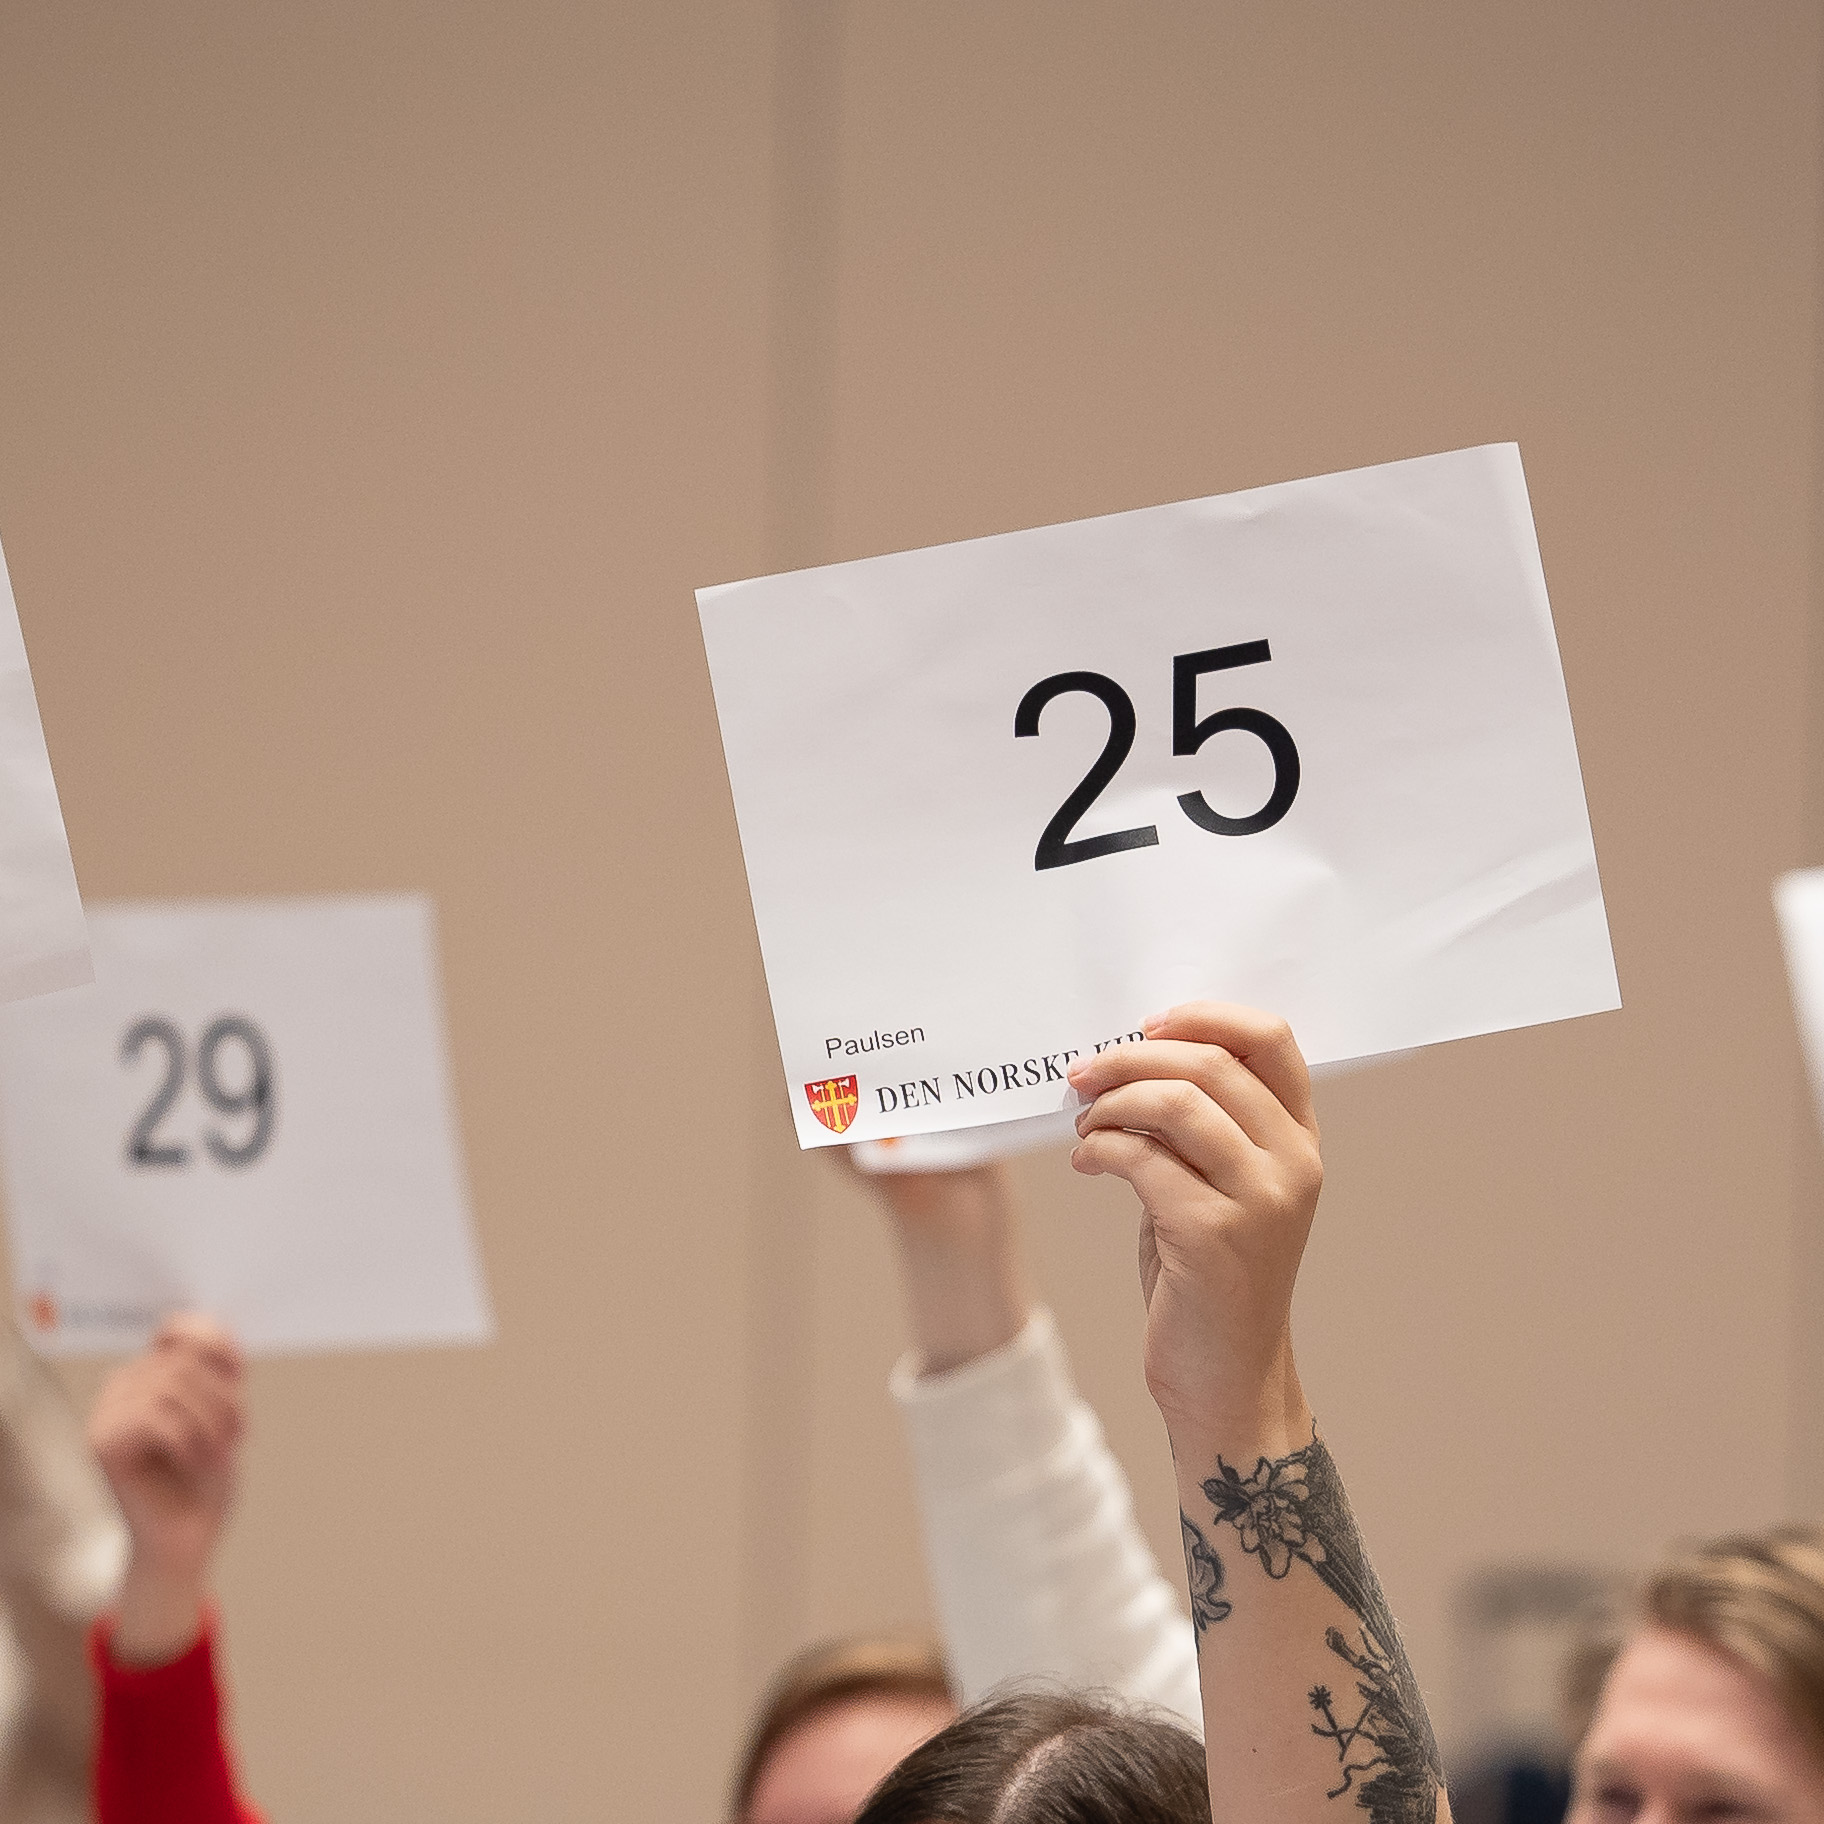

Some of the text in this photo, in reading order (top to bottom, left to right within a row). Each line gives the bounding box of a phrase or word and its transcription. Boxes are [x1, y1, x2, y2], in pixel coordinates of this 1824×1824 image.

[1014, 638, 1301, 872] 25
[824, 1026, 926, 1059] Paulsen
[119, 1014, 278, 1172] 29
[875, 1076, 943, 1115] DEN
